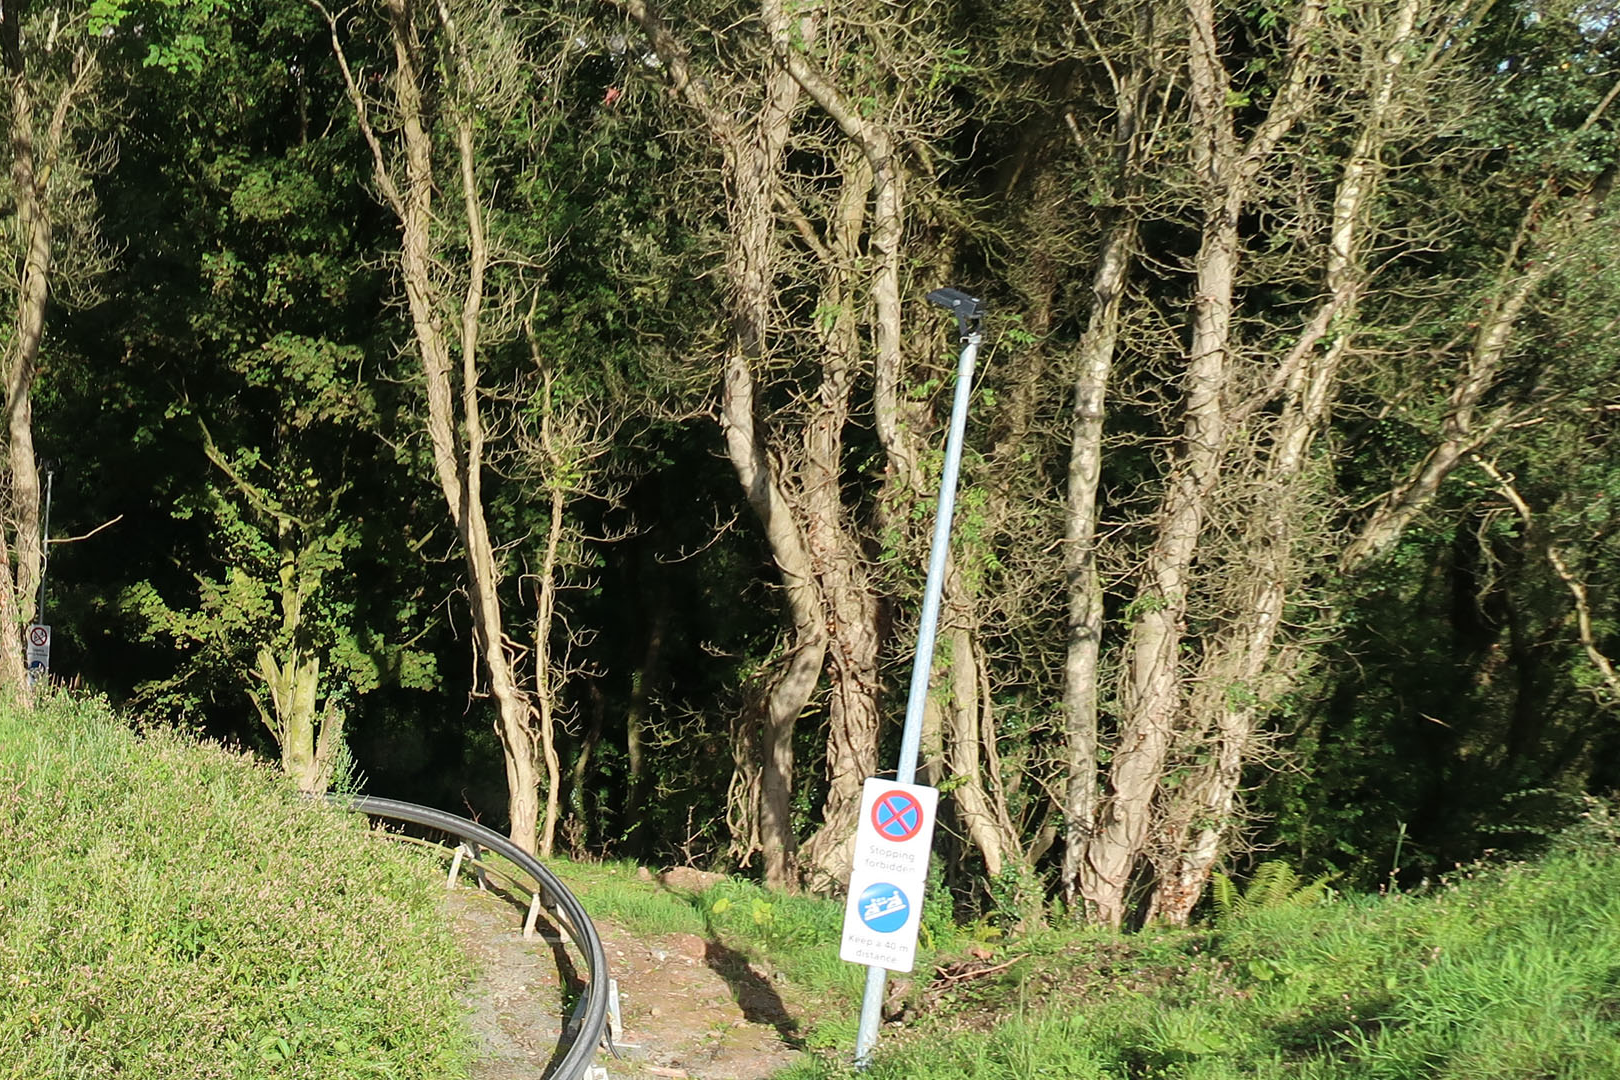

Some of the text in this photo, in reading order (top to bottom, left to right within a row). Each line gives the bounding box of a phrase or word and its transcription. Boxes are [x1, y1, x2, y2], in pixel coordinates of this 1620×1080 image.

[869, 844, 915, 863] Stopping
[864, 857, 916, 872] forbidden
[848, 935, 873, 947] Keep
[855, 949, 897, 963] distance
